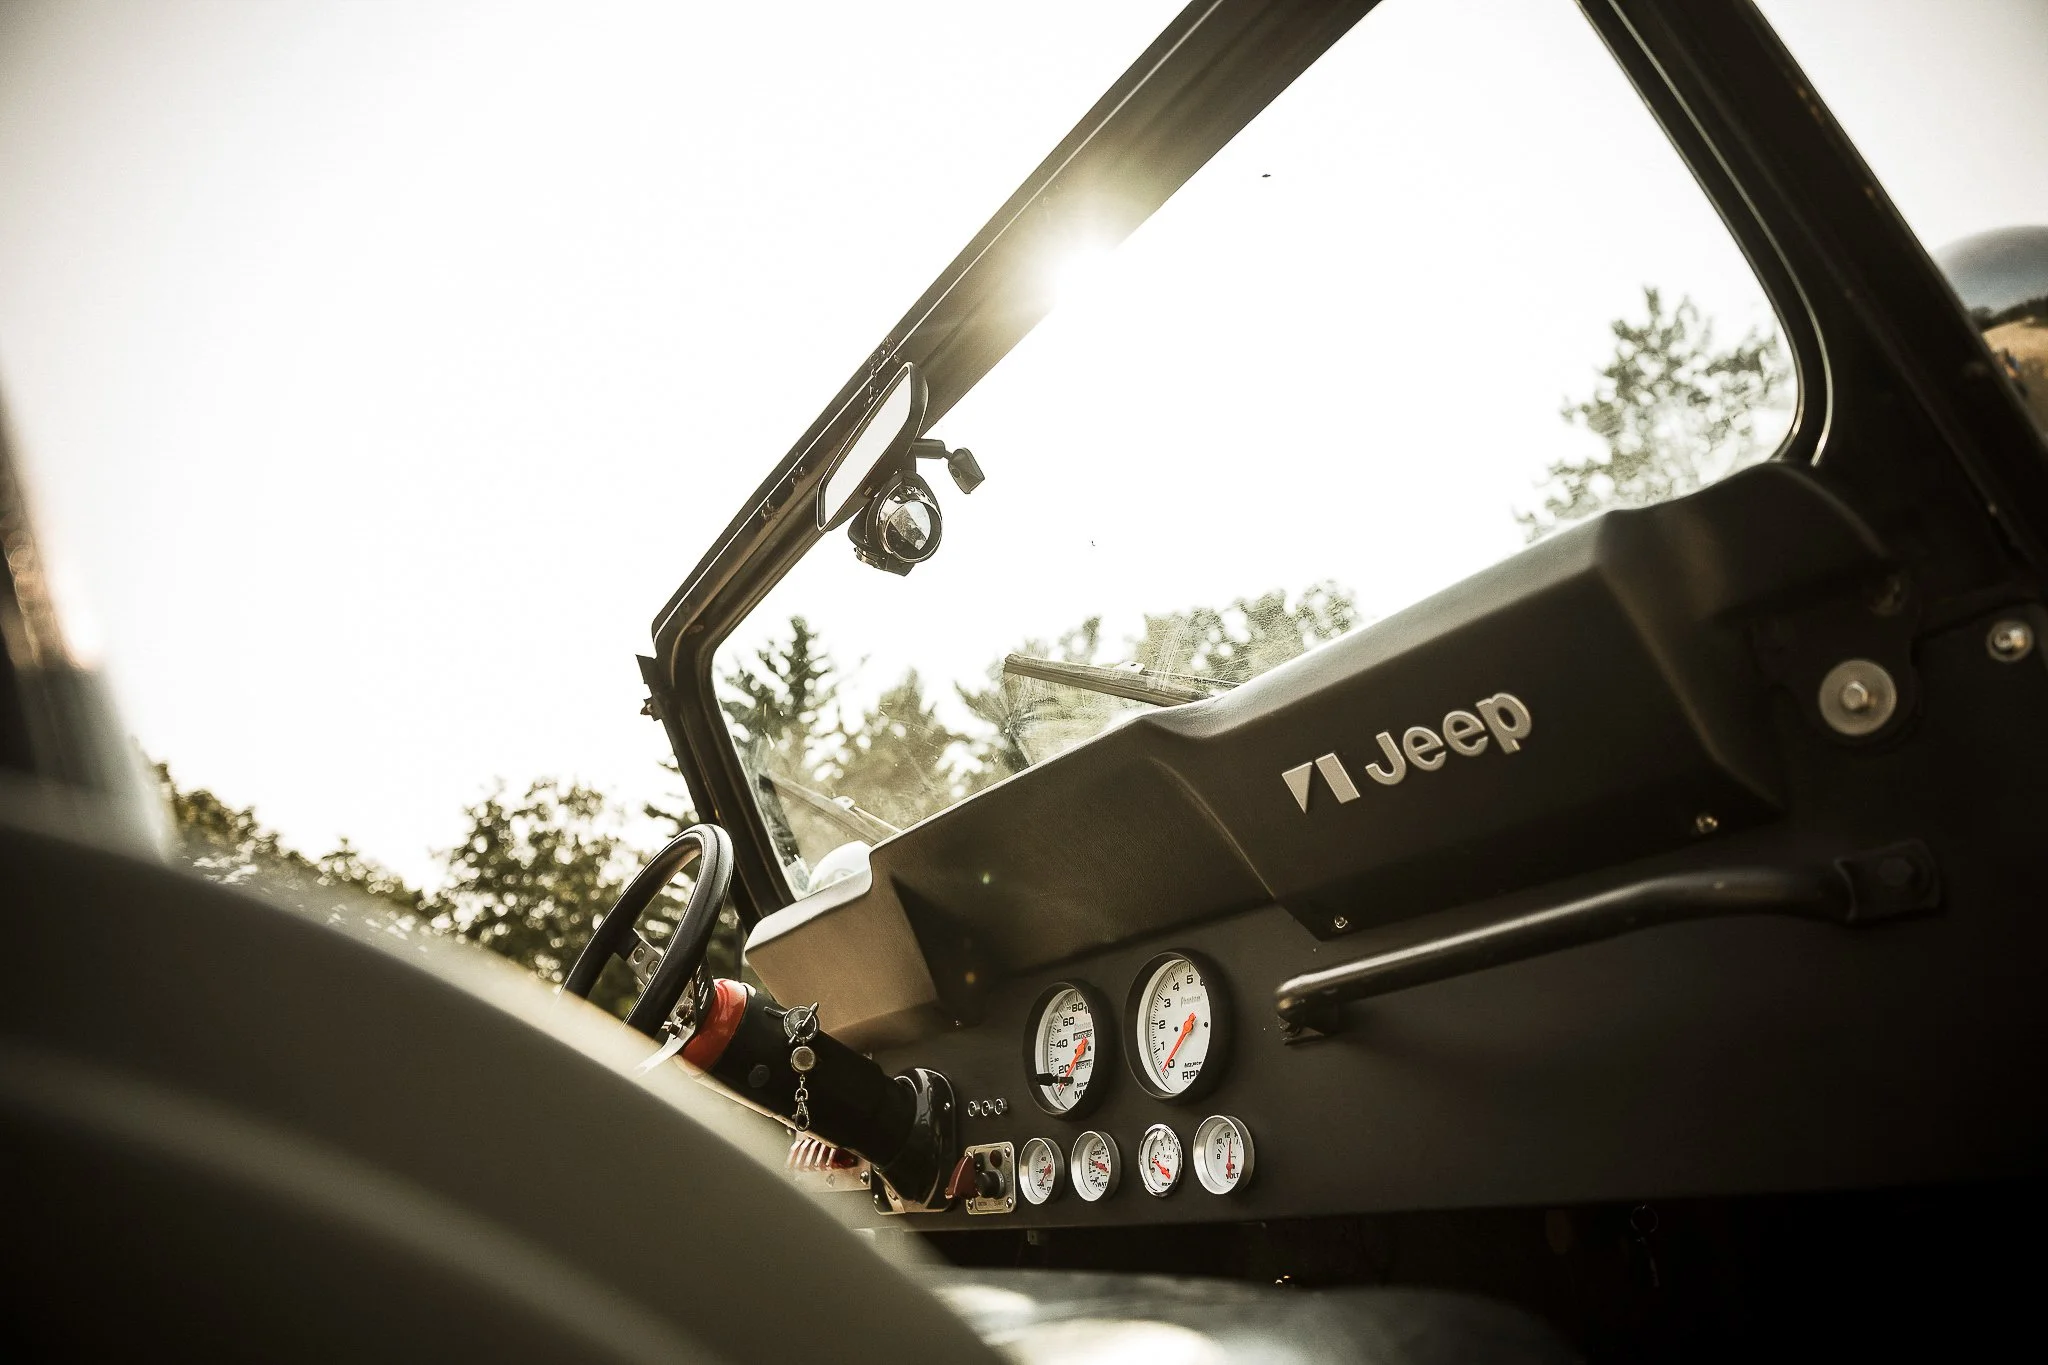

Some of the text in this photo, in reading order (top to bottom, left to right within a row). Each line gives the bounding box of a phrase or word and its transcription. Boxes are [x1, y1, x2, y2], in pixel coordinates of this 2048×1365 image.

[1365, 692, 1533, 786] Jeep
[1186, 974, 1194, 984] 5
[1172, 981, 1180, 992] 4
[1071, 1002, 1083, 1012] 80
[1163, 998, 1171, 1008] 3
[1062, 1016, 1075, 1027] 60
[1158, 1019, 1166, 1029] 2
[1056, 1038, 1068, 1049] 40
[1160, 1041, 1165, 1051] 1
[1167, 1058, 1175, 1068] 0
[1058, 1063, 1070, 1074] 20
[1224, 1131, 1231, 1139] 12
[1216, 1137, 1223, 1145] 10
